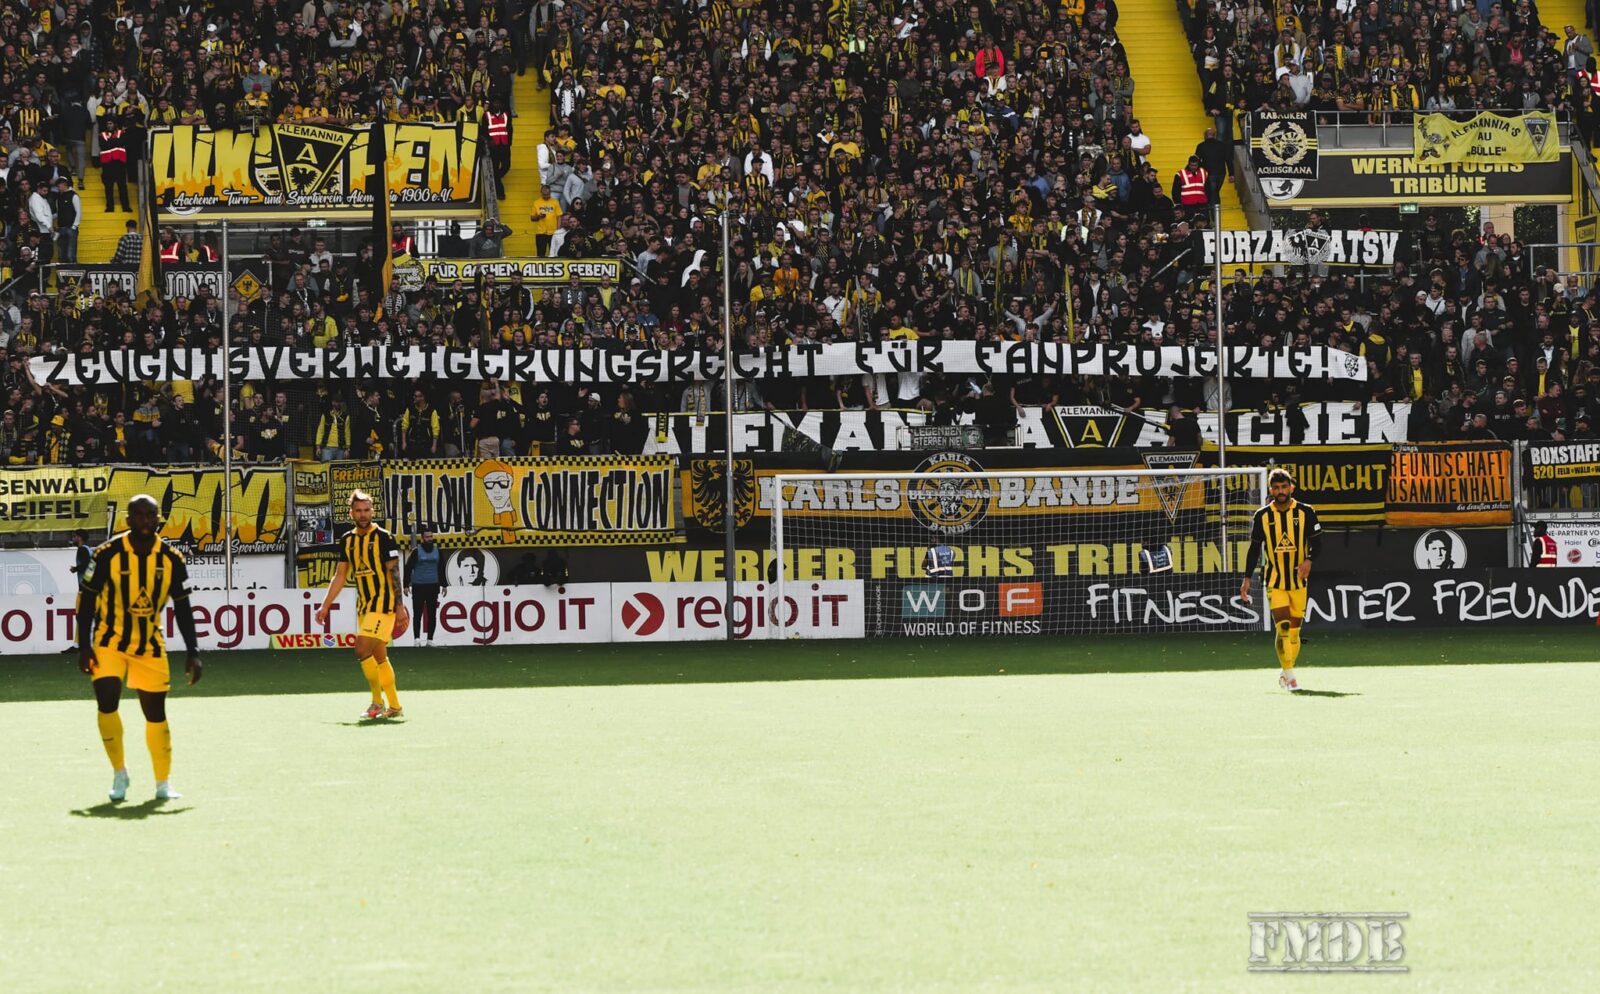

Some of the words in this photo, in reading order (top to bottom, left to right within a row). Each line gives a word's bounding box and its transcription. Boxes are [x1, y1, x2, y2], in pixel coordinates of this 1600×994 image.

[278, 124, 344, 143] ALEMANNIA
[1477, 132, 1492, 141] AU
[1257, 166, 1313, 175] AQUISGRANA
[1390, 175, 1487, 194] TRIBÜNE
[173, 192, 219, 206] Aachener
[222, 189, 258, 206] Turn-
[263, 194, 281, 206] und
[285, 190, 343, 206] Sportverein
[401, 188, 430, 203] 1900
[1203, 230, 1287, 264] FORZA
[1328, 230, 1399, 265] ATSV
[429, 264, 458, 279] FÜR
[523, 262, 563, 276] ALLES
[568, 262, 616, 277] GEBEN!
[856, 340, 944, 373] FÜR
[928, 453, 971, 465] KARLS
[1149, 454, 1193, 462] ALEMANNIA
[1533, 466, 1554, 479] 520
[759, 477, 901, 511] KARLS
[998, 474, 1139, 508] BANDE
[384, 472, 472, 534] YELLOW
[521, 470, 669, 529] CONNECTION
[930, 523, 972, 534] BANDE
[205, 541, 224, 552] und
[558, 587, 595, 630] iT
[677, 584, 798, 639] regio
[811, 583, 849, 627] iT
[1087, 583, 1260, 624] FITNESS
[1304, 582, 1415, 622] NTER
[904, 623, 954, 636] WORLD
[959, 622, 976, 634] OF
[981, 620, 1041, 634] FITNESS
[276, 634, 321, 648] WEST
